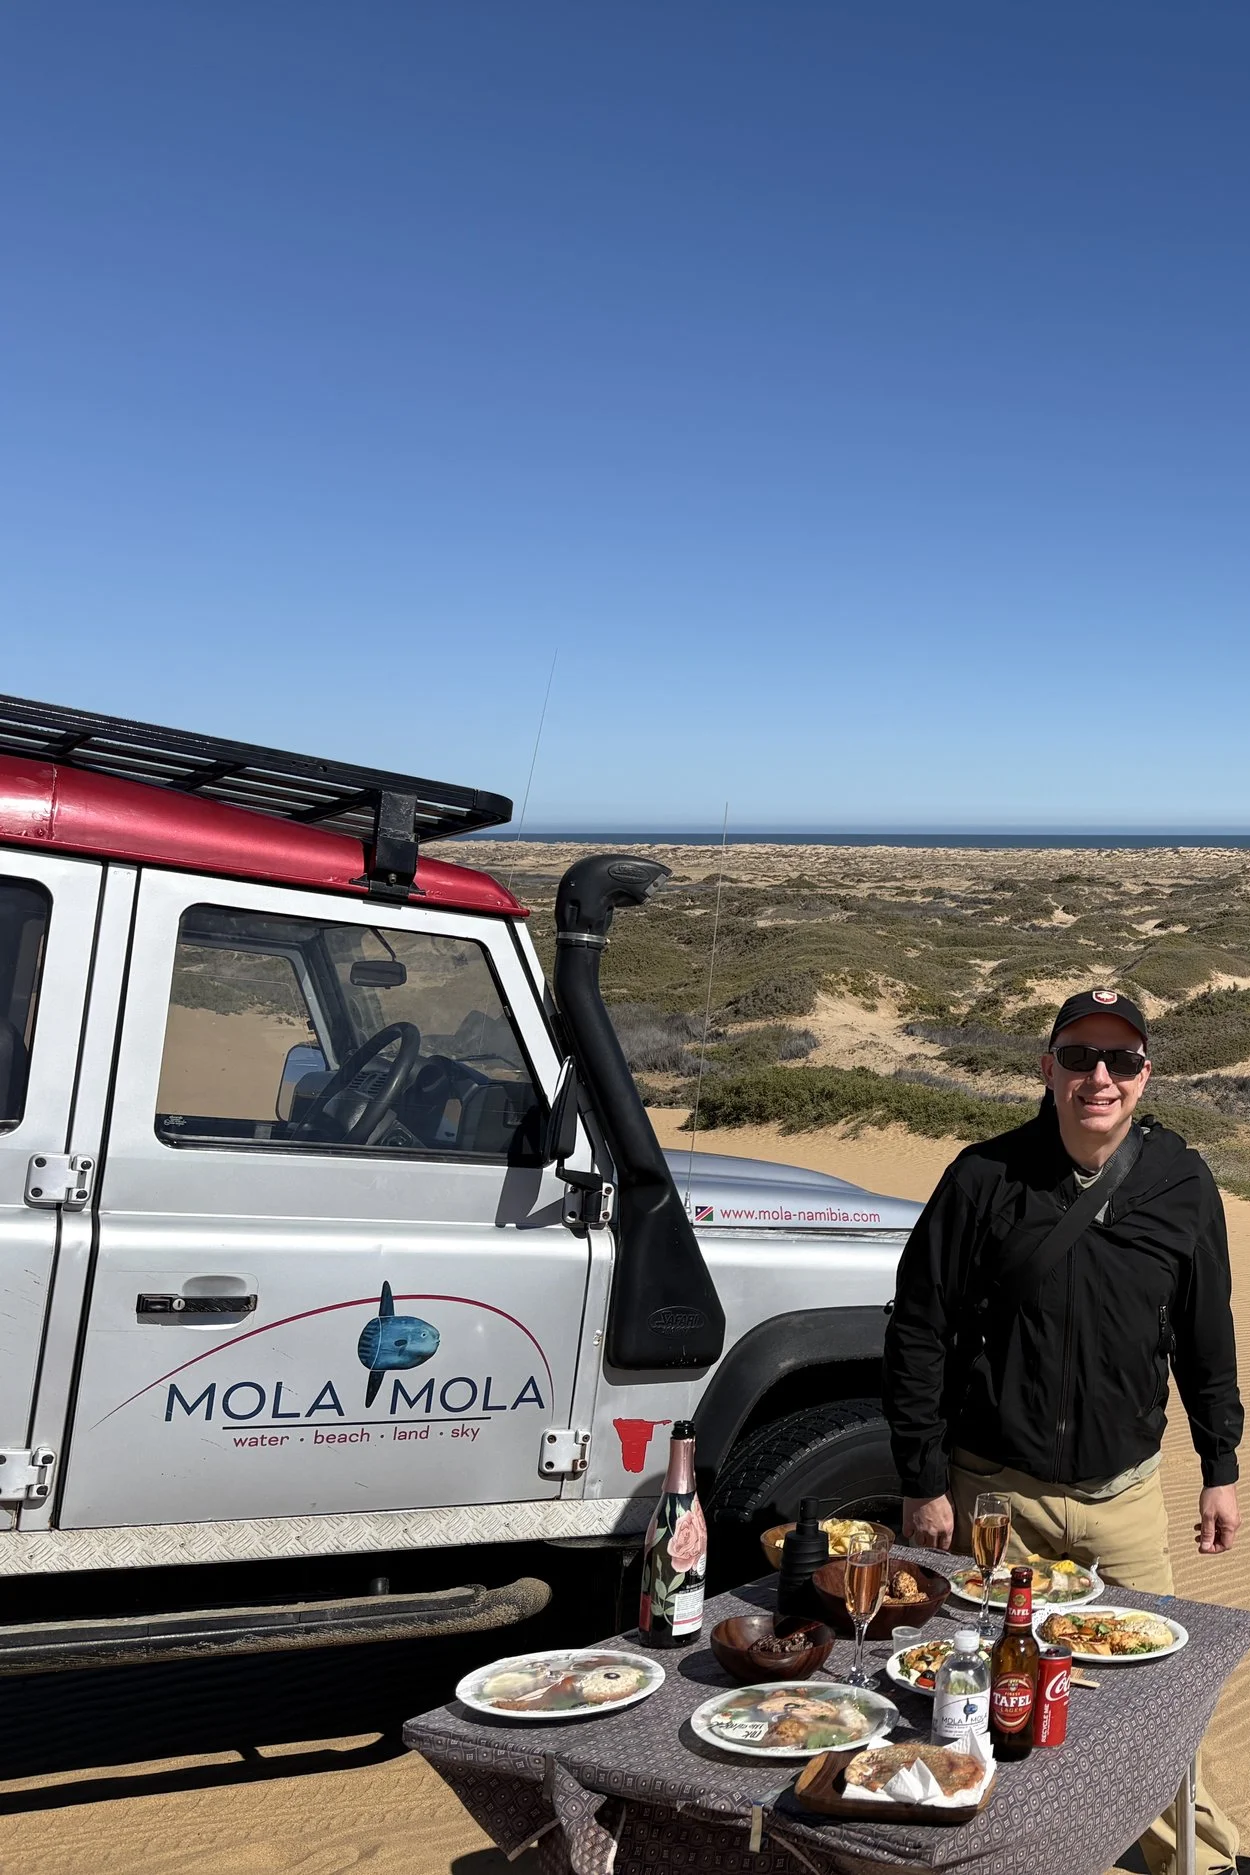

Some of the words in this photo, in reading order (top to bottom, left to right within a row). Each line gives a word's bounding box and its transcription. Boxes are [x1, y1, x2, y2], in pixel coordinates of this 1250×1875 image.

[720, 1206, 881, 1223] www.mola-namibia.com
[164, 1380, 345, 1422] MOLA
[389, 1375, 546, 1415] MOLA
[233, 1433, 290, 1447] water
[314, 1428, 371, 1445] beach
[393, 1425, 430, 1441] land
[451, 1423, 481, 1442] sky
[1008, 1607, 1030, 1616] TAFEL
[993, 1692, 1032, 1708] TAFEL
[1044, 1703, 1050, 1714] ME
[941, 1716, 963, 1725] MOLA
[1041, 1714, 1049, 1743] RECYCLE
